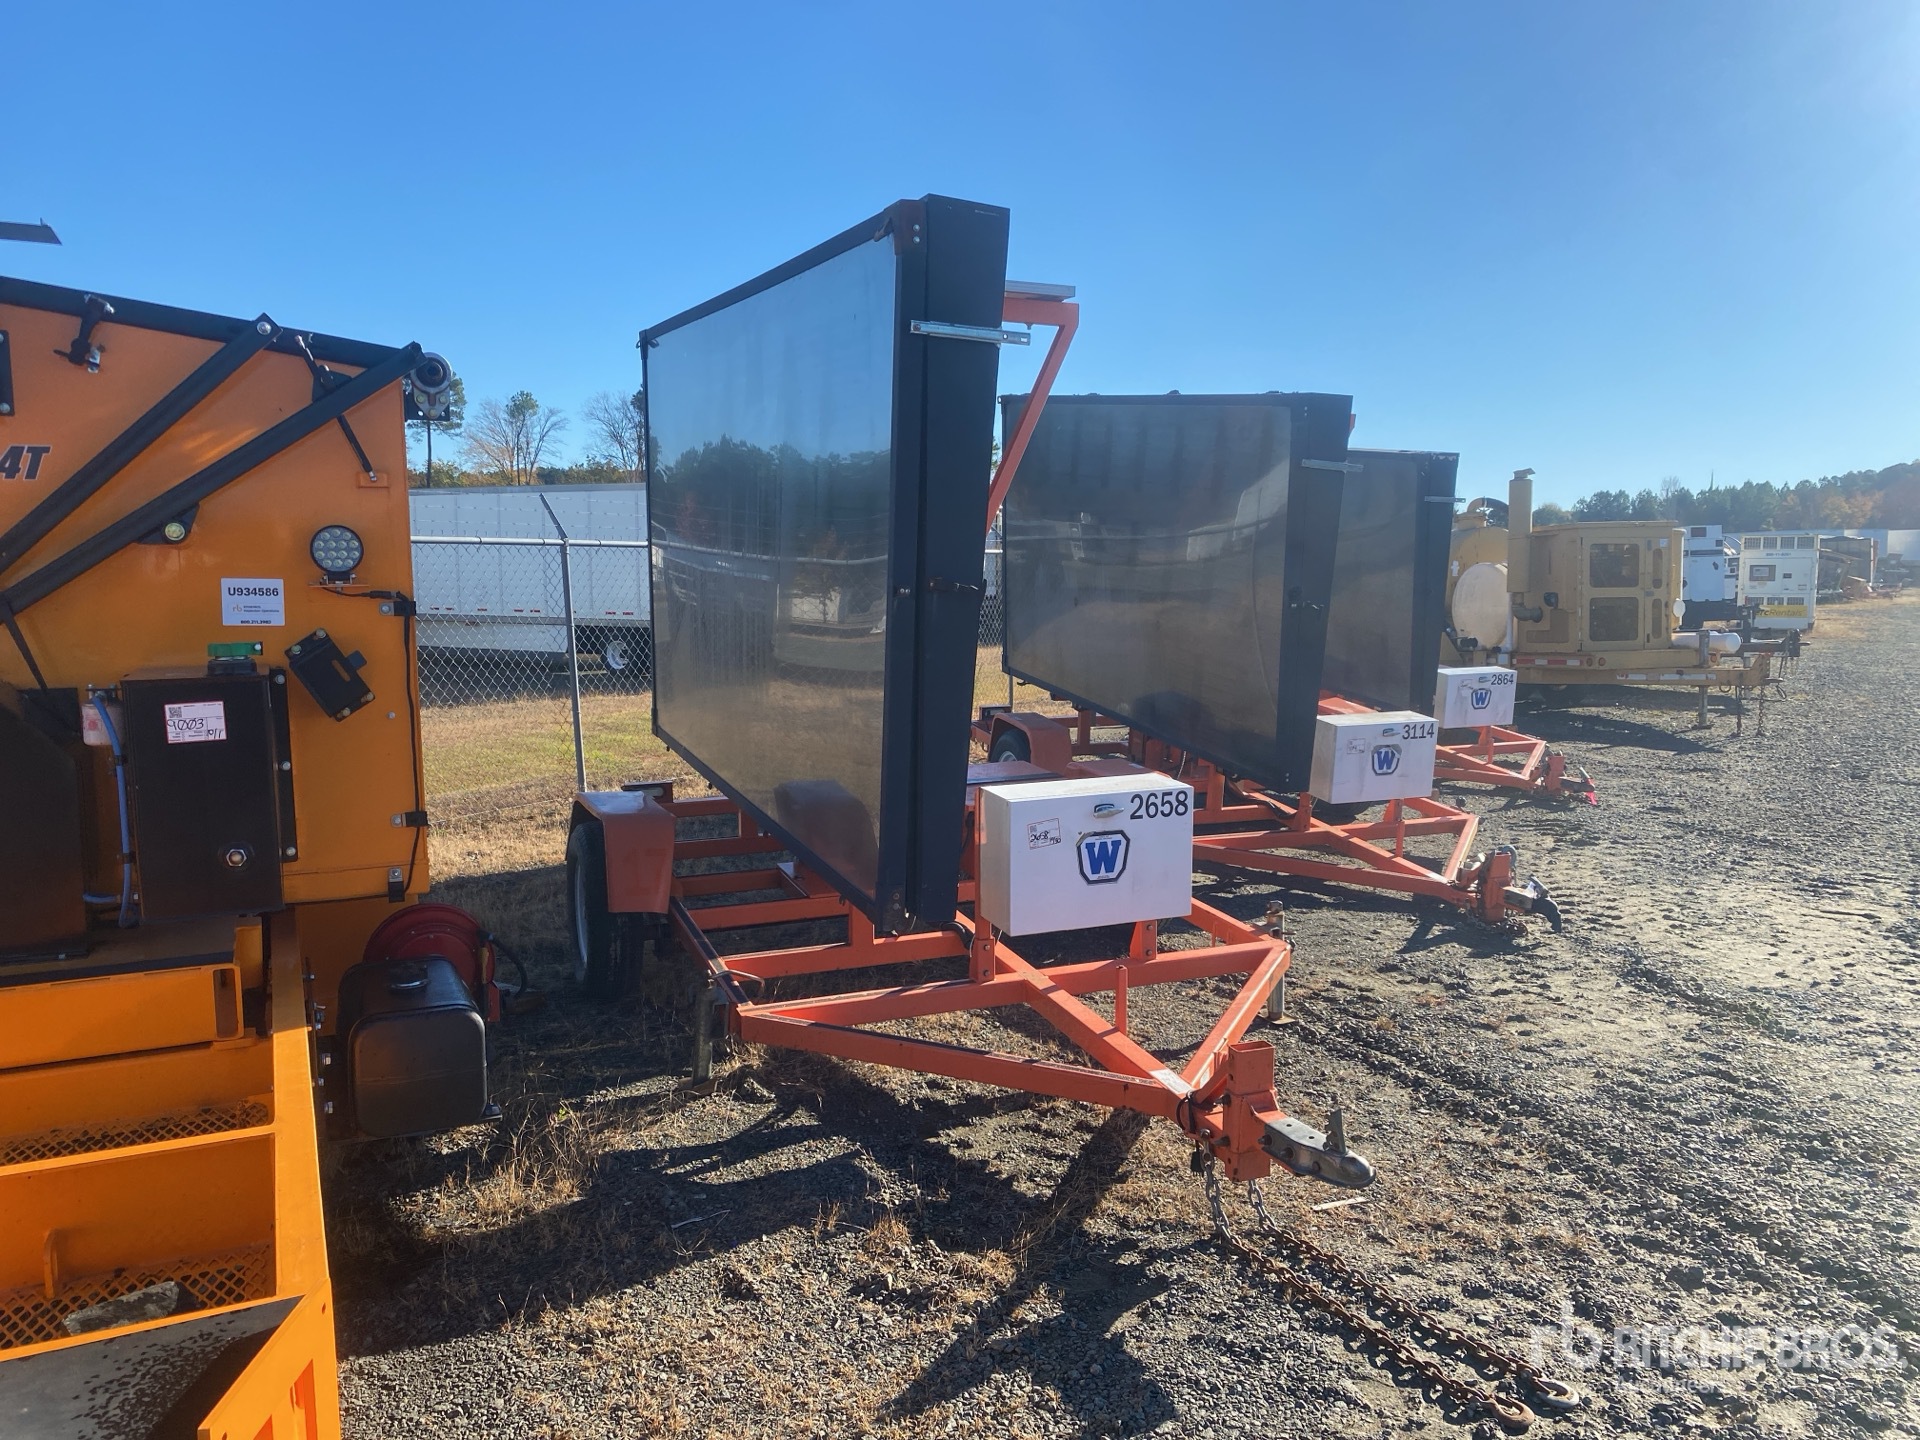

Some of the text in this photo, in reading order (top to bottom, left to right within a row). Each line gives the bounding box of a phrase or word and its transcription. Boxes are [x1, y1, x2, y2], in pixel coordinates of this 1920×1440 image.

[228, 587, 279, 597] U934586
[1491, 674, 1514, 686] 2864
[1474, 691, 1489, 706] W
[1402, 723, 1435, 740] 3114
[1376, 750, 1396, 770] W
[1130, 790, 1189, 820] 2658
[1085, 839, 1122, 875] W
